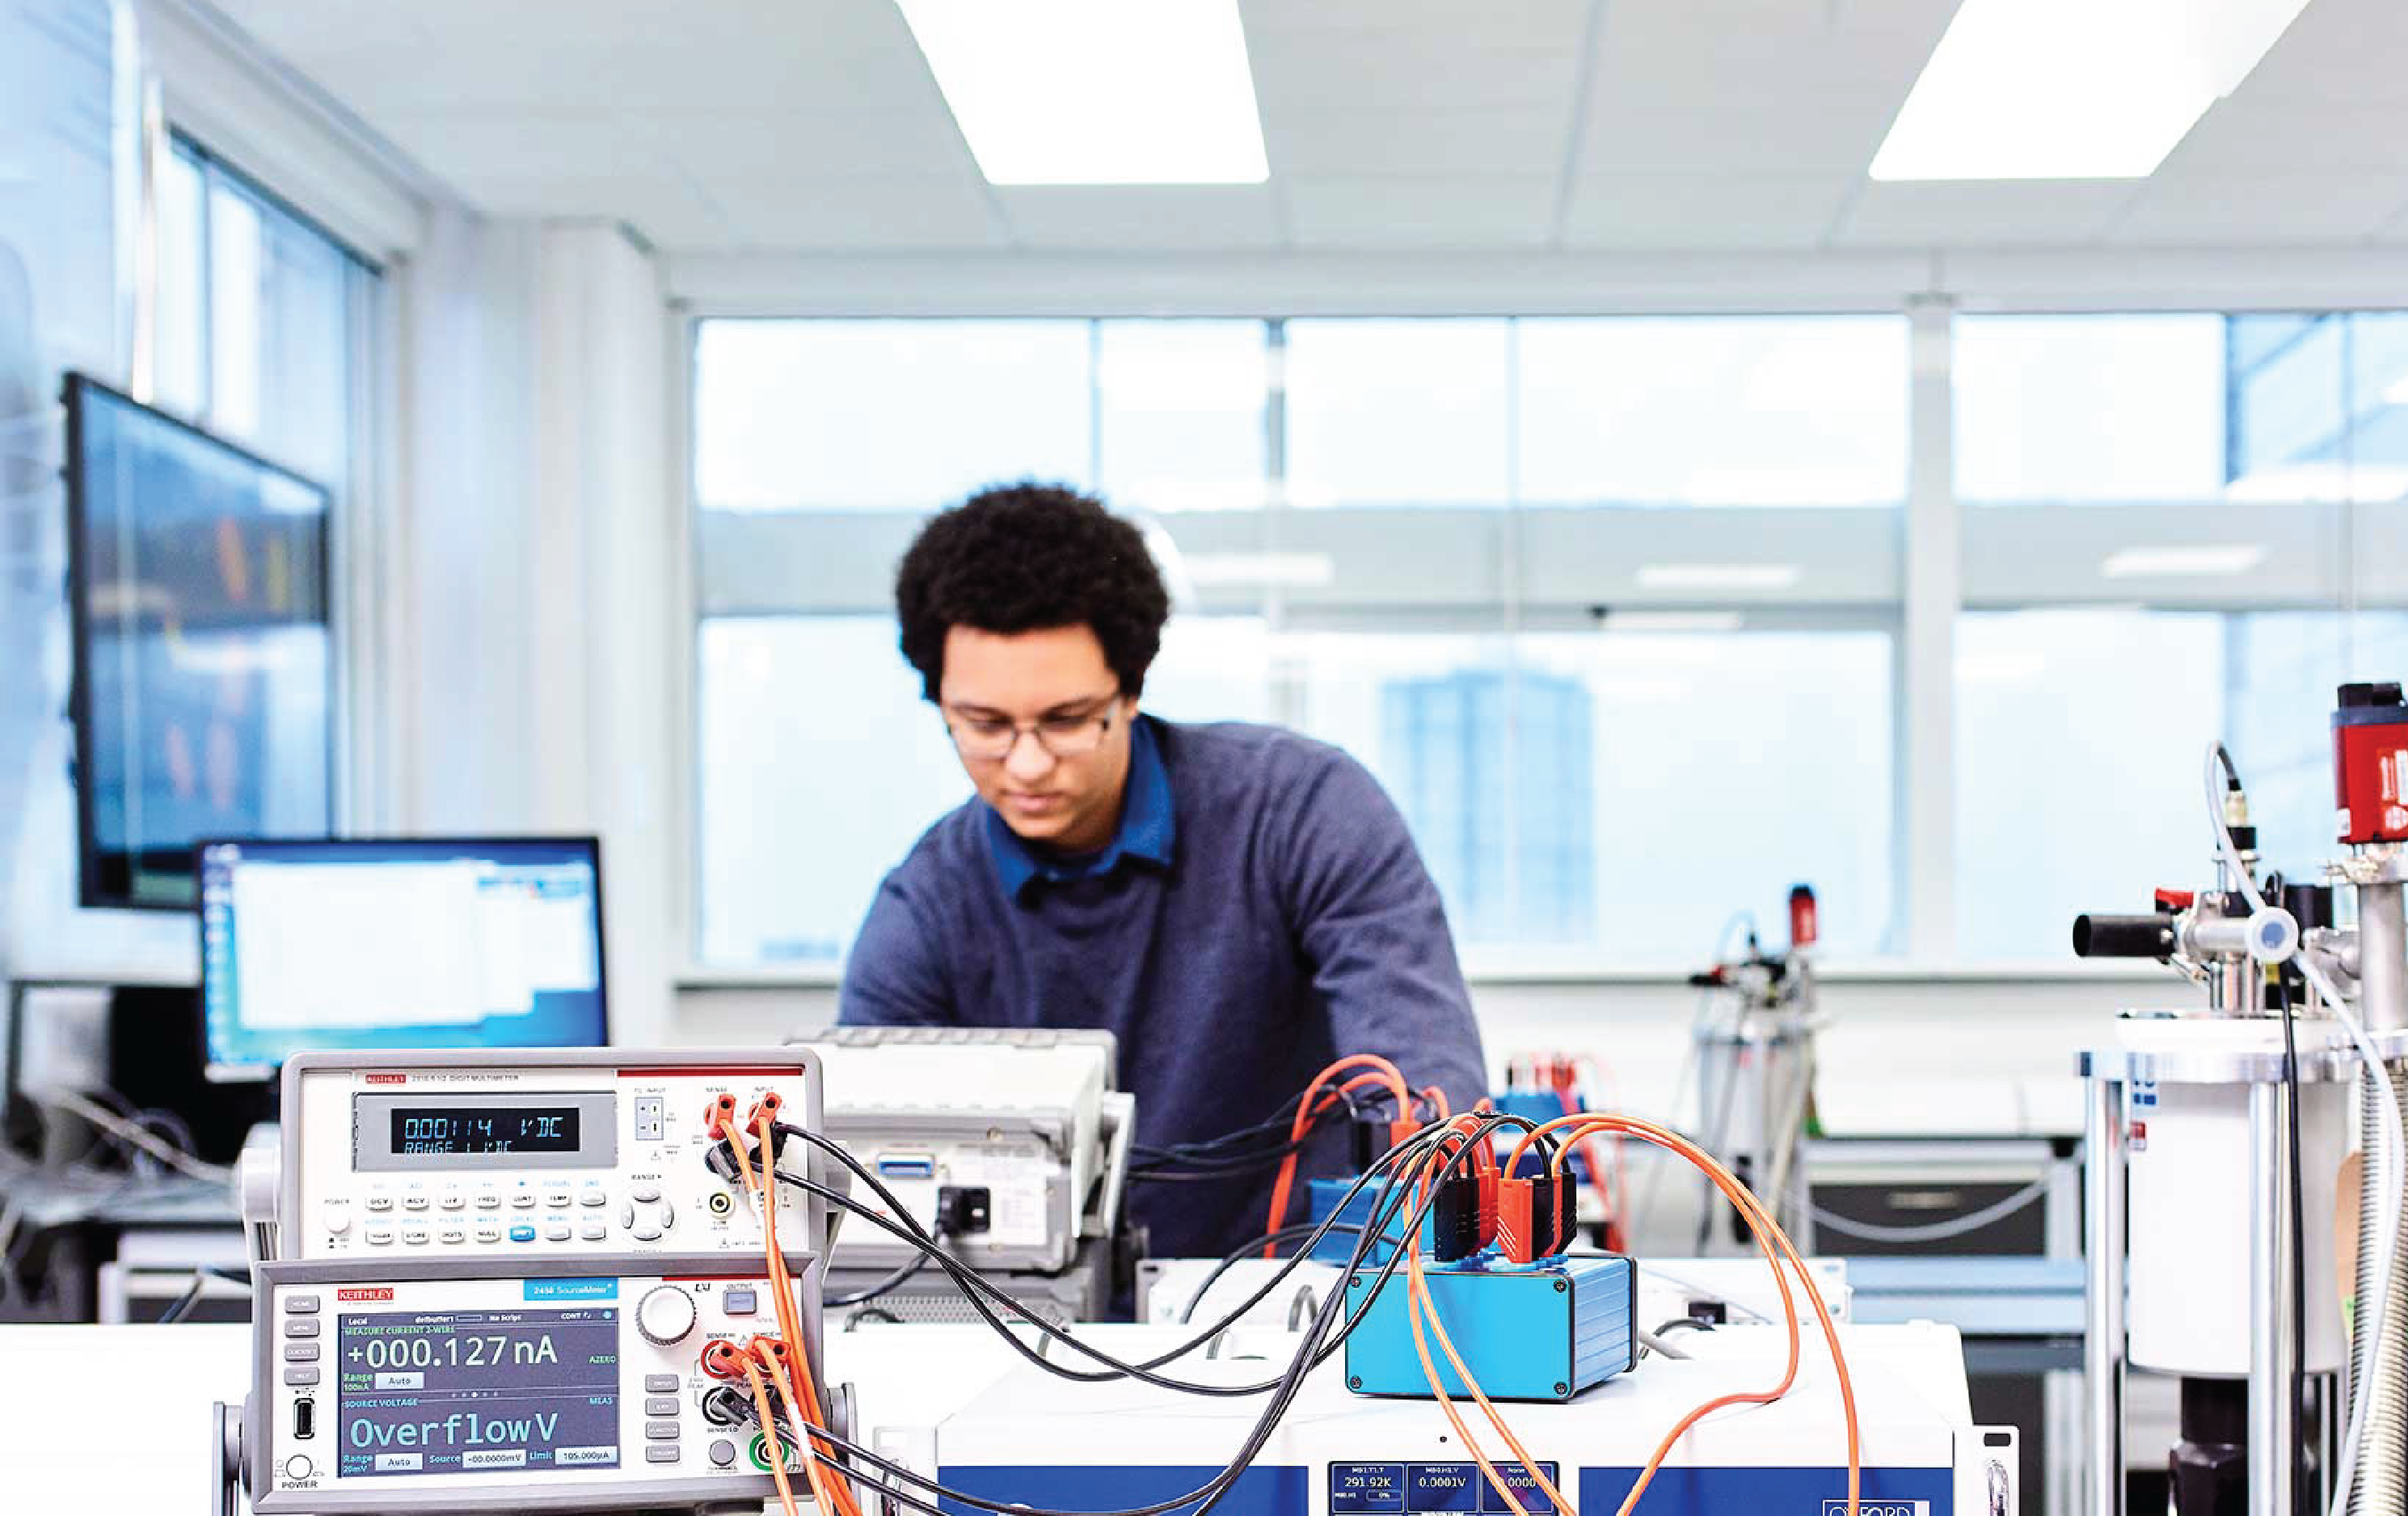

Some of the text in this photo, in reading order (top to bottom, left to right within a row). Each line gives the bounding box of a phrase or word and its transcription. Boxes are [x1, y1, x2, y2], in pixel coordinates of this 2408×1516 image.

[339, 1290, 393, 1300] KEITHLEY
[348, 1317, 368, 1325] Local
[345, 1327, 384, 1337] MEASURE
[386, 1326, 424, 1336] CURRENT
[344, 1374, 411, 1385] Range Auto
[345, 1398, 418, 1408] SOURCE VOLTAGE
[588, 1396, 613, 1405] MEAS
[344, 1455, 373, 1464] Range
[388, 1457, 411, 1466] Auto
[429, 1455, 462, 1464] Source
[529, 1451, 553, 1460] Limit
[281, 1480, 318, 1489] POWER
[1344, 1476, 1392, 1487] 291.92K
[1419, 1476, 1466, 1488] 0.0001V
